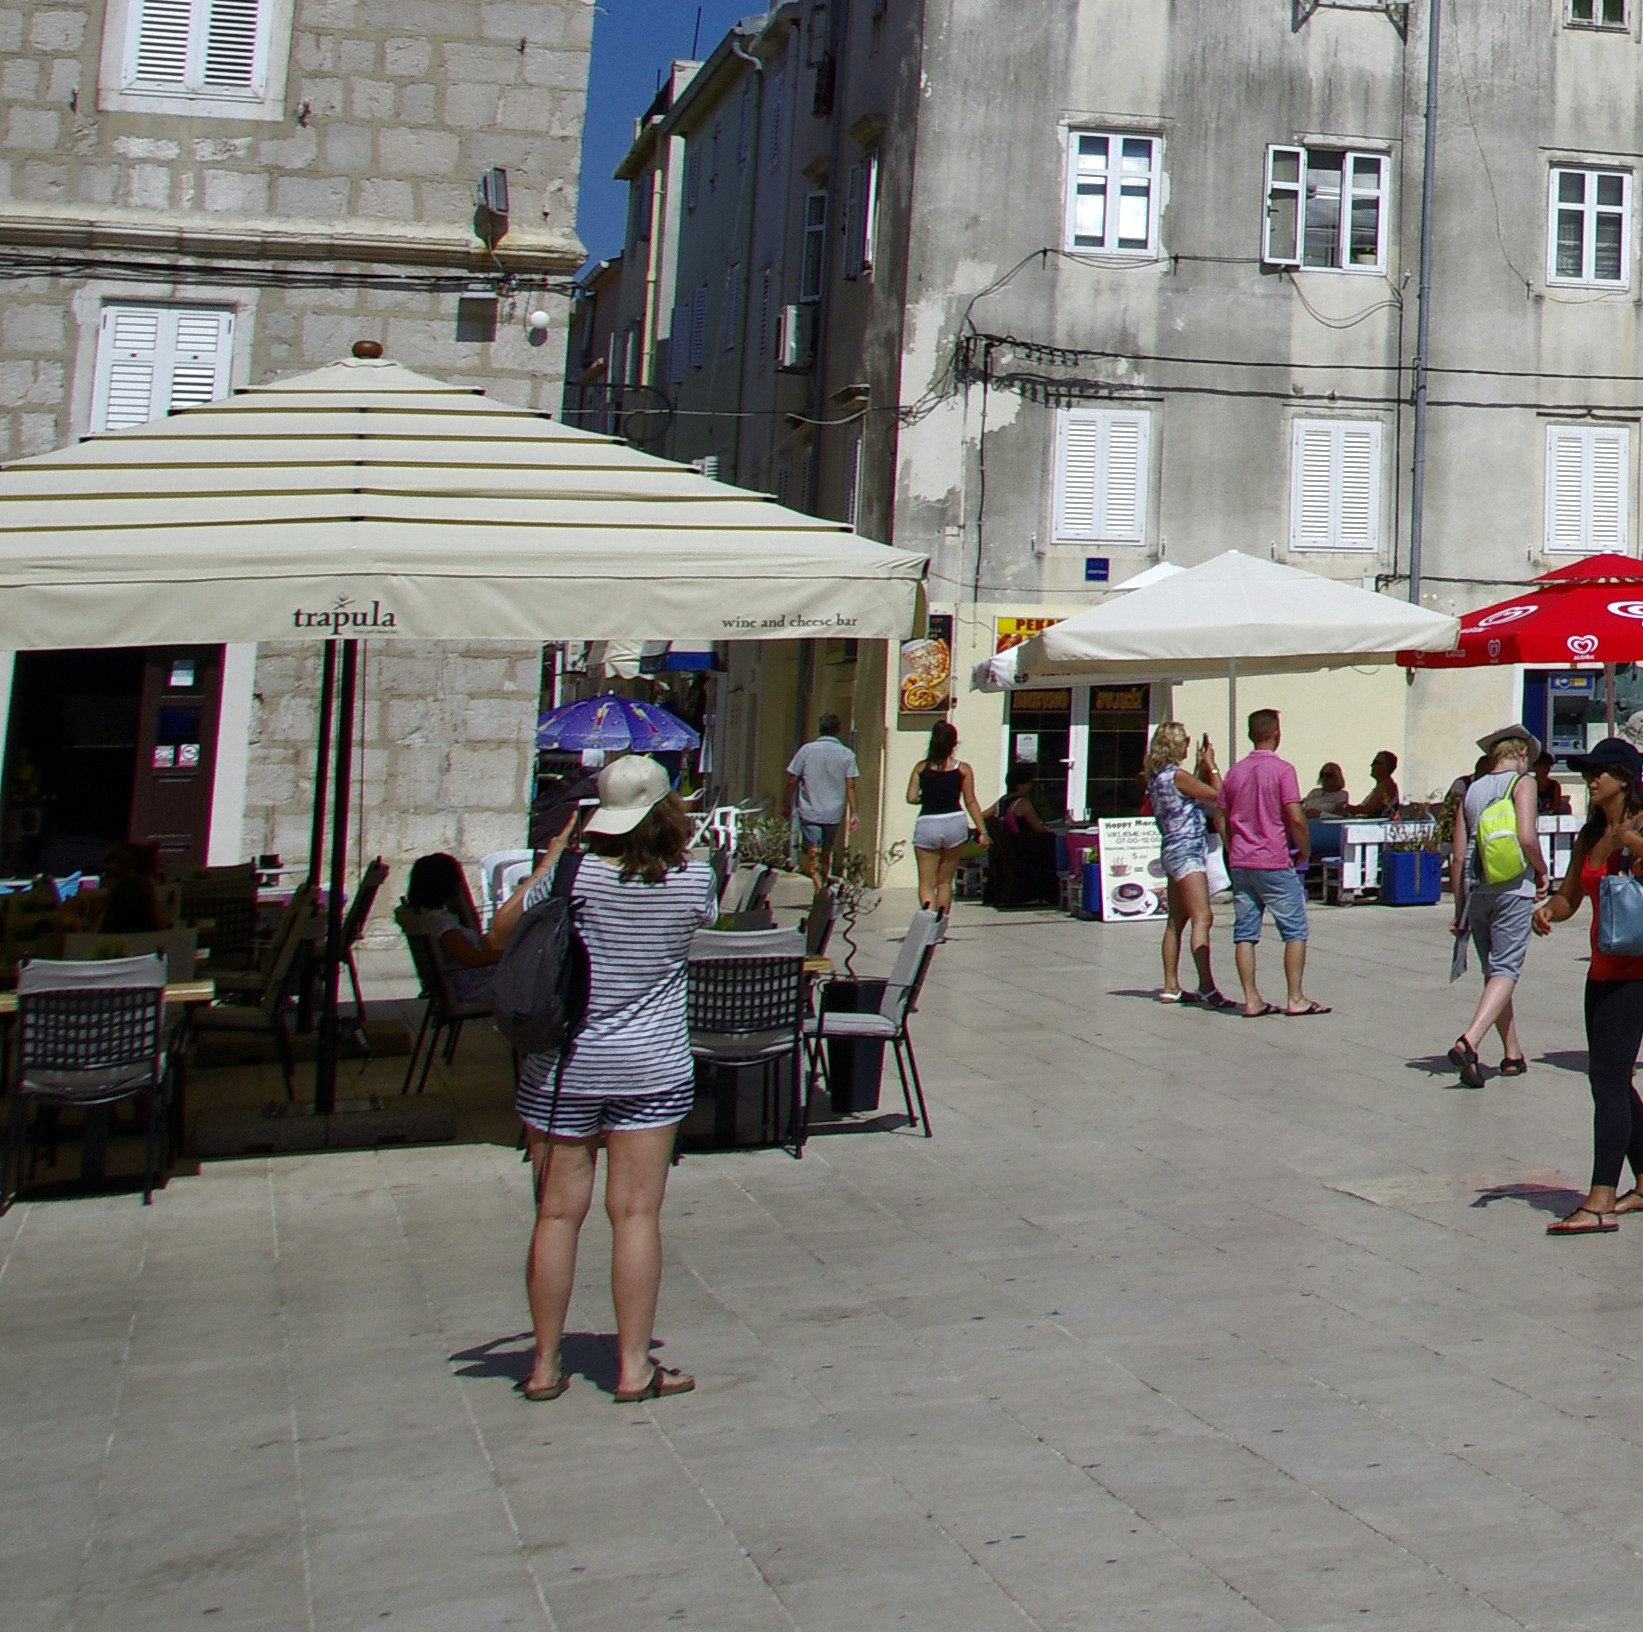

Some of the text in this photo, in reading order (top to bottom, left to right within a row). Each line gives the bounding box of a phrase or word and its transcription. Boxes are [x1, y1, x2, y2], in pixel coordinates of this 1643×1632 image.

[292, 600, 397, 635] trapula
[722, 613, 858, 628] wine and cheese bar
[1016, 618, 1058, 630] PEKA
